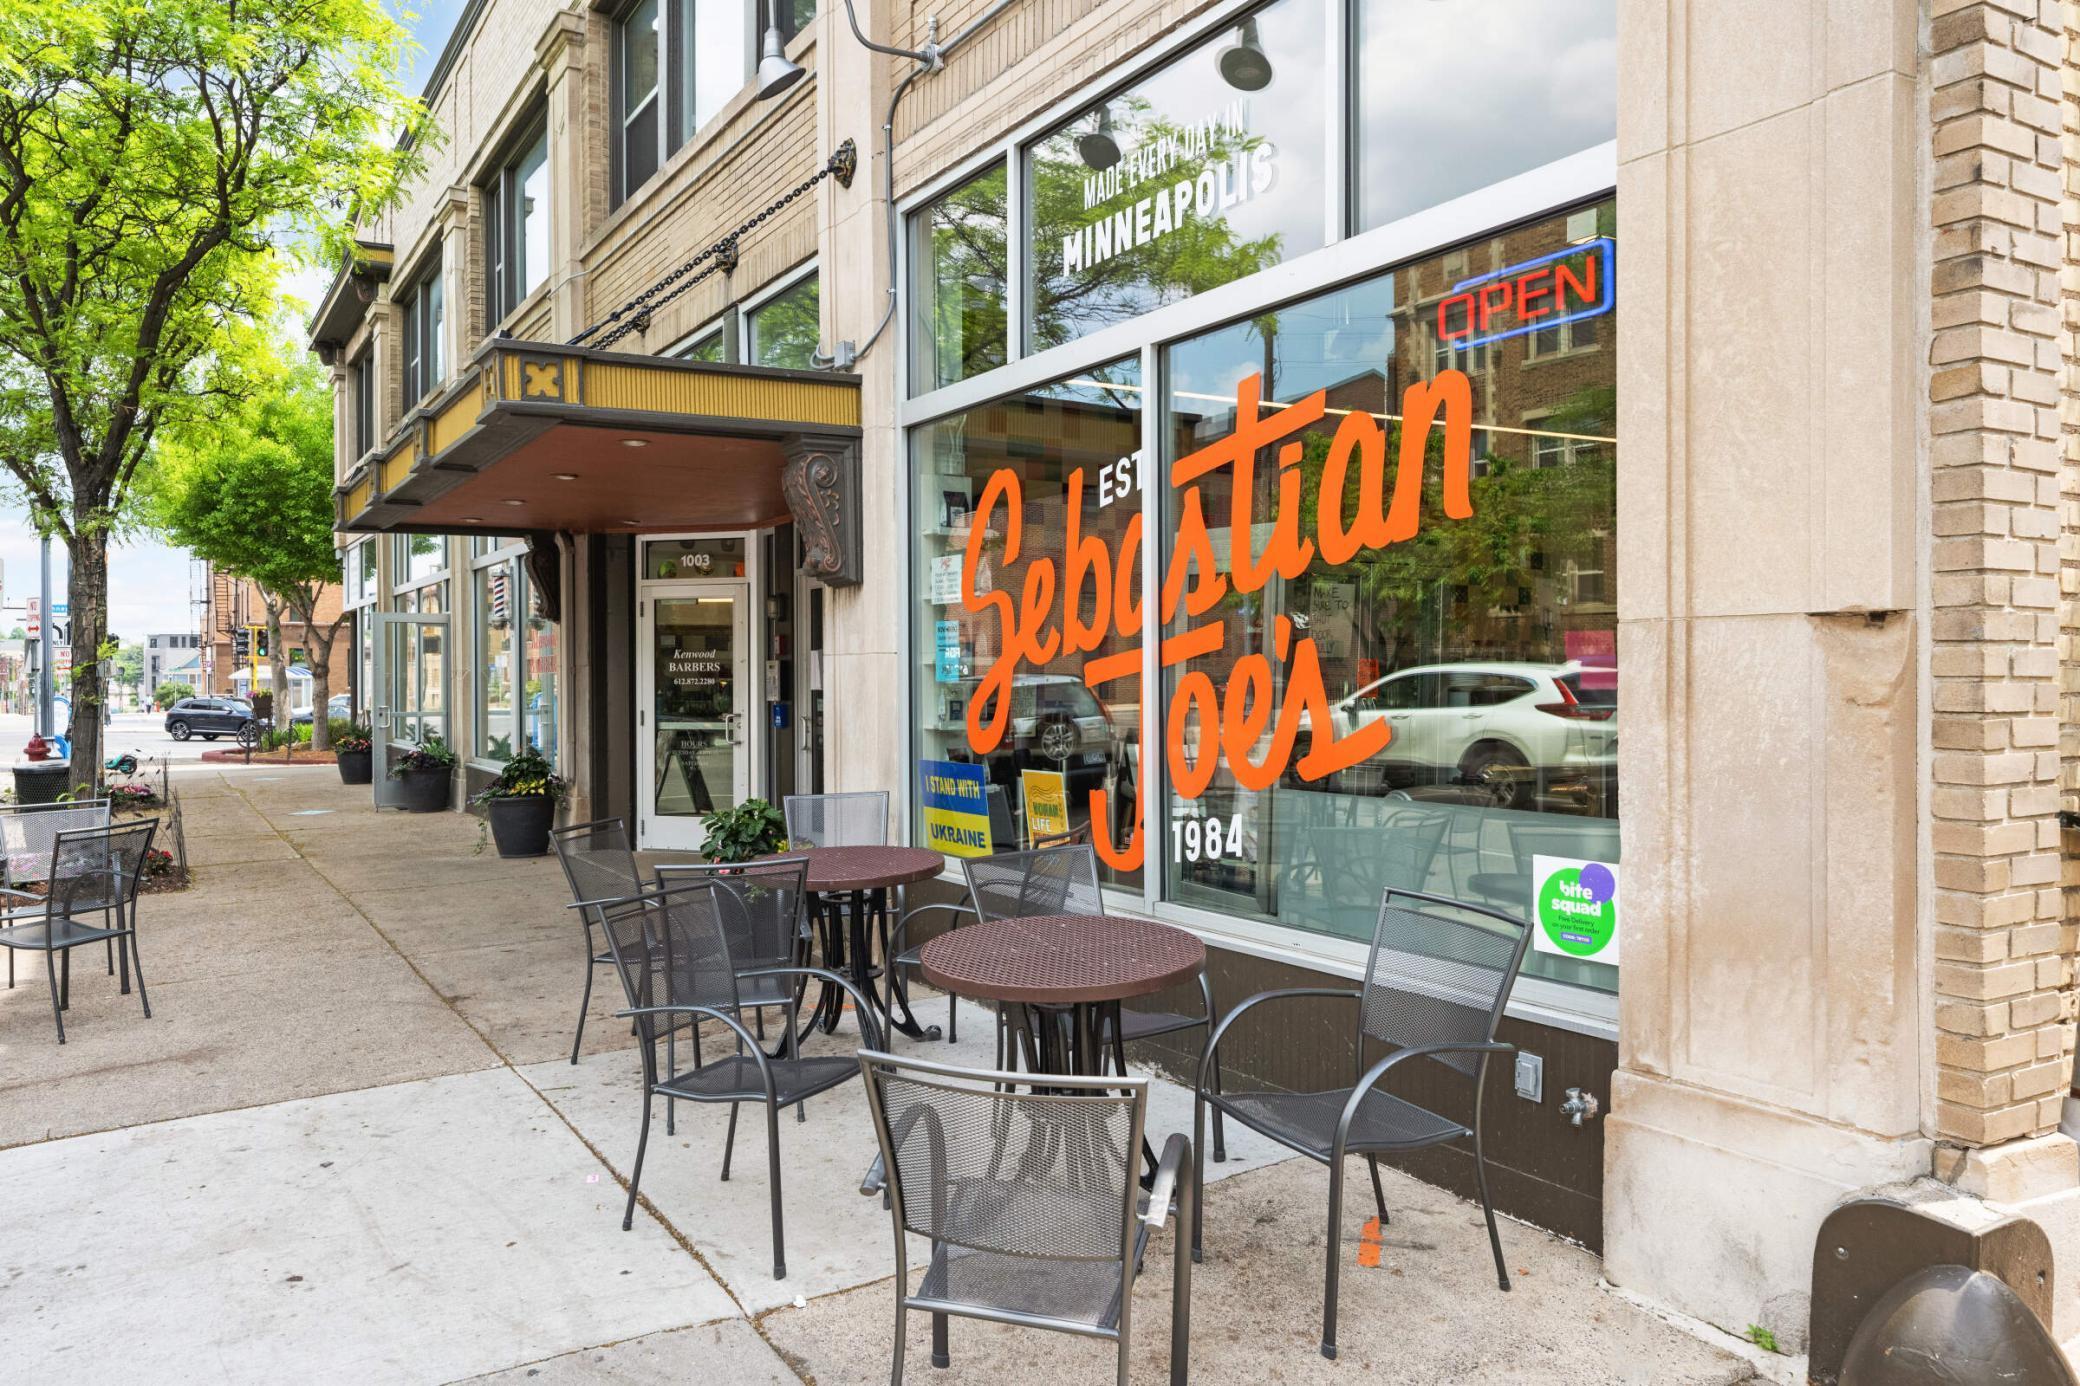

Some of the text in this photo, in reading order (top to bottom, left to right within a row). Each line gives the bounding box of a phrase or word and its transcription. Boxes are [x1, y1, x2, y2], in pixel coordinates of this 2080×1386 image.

[1084, 97, 1244, 210] MADE EVERY DAY IN
[1063, 143, 1274, 277] MINNEAPOLIS
[1437, 254, 1597, 342] OPEN
[680, 554, 711, 568] 1003
[961, 369, 1474, 756] Sebastian
[669, 662, 721, 672] BARBERS
[673, 648, 717, 660] Kenwood
[1083, 613, 1392, 873] Joe's
[925, 775, 981, 800] I STAND WITH
[930, 822, 987, 849] UKRAINE
[1031, 817, 1052, 833] LIFE
[1172, 813, 1243, 864] 1984
[1559, 880, 1593, 900] bite
[1551, 898, 1602, 917] squad
